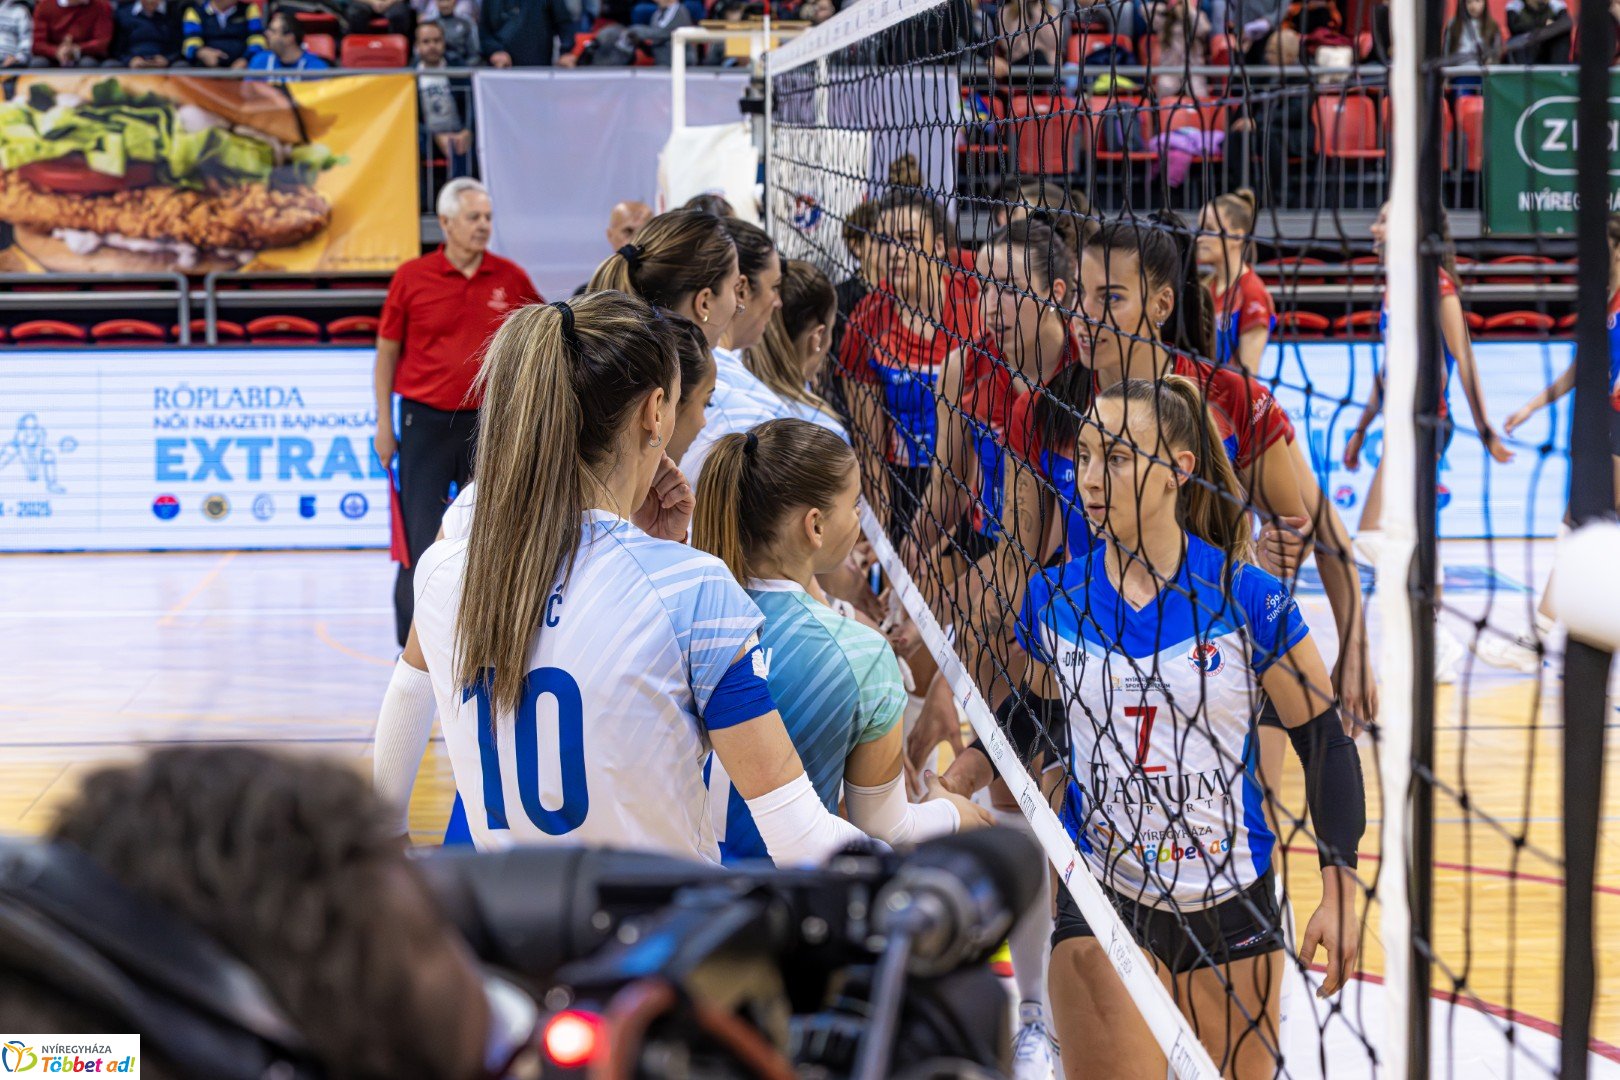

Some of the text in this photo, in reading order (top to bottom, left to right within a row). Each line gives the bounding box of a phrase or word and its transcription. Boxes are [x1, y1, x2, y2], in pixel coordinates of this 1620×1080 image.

[195, 414, 276, 428] NEMZETI
[282, 411, 378, 430] BAJNOKSÁ
[463, 667, 589, 835] 10
[1124, 706, 1158, 766] 7
